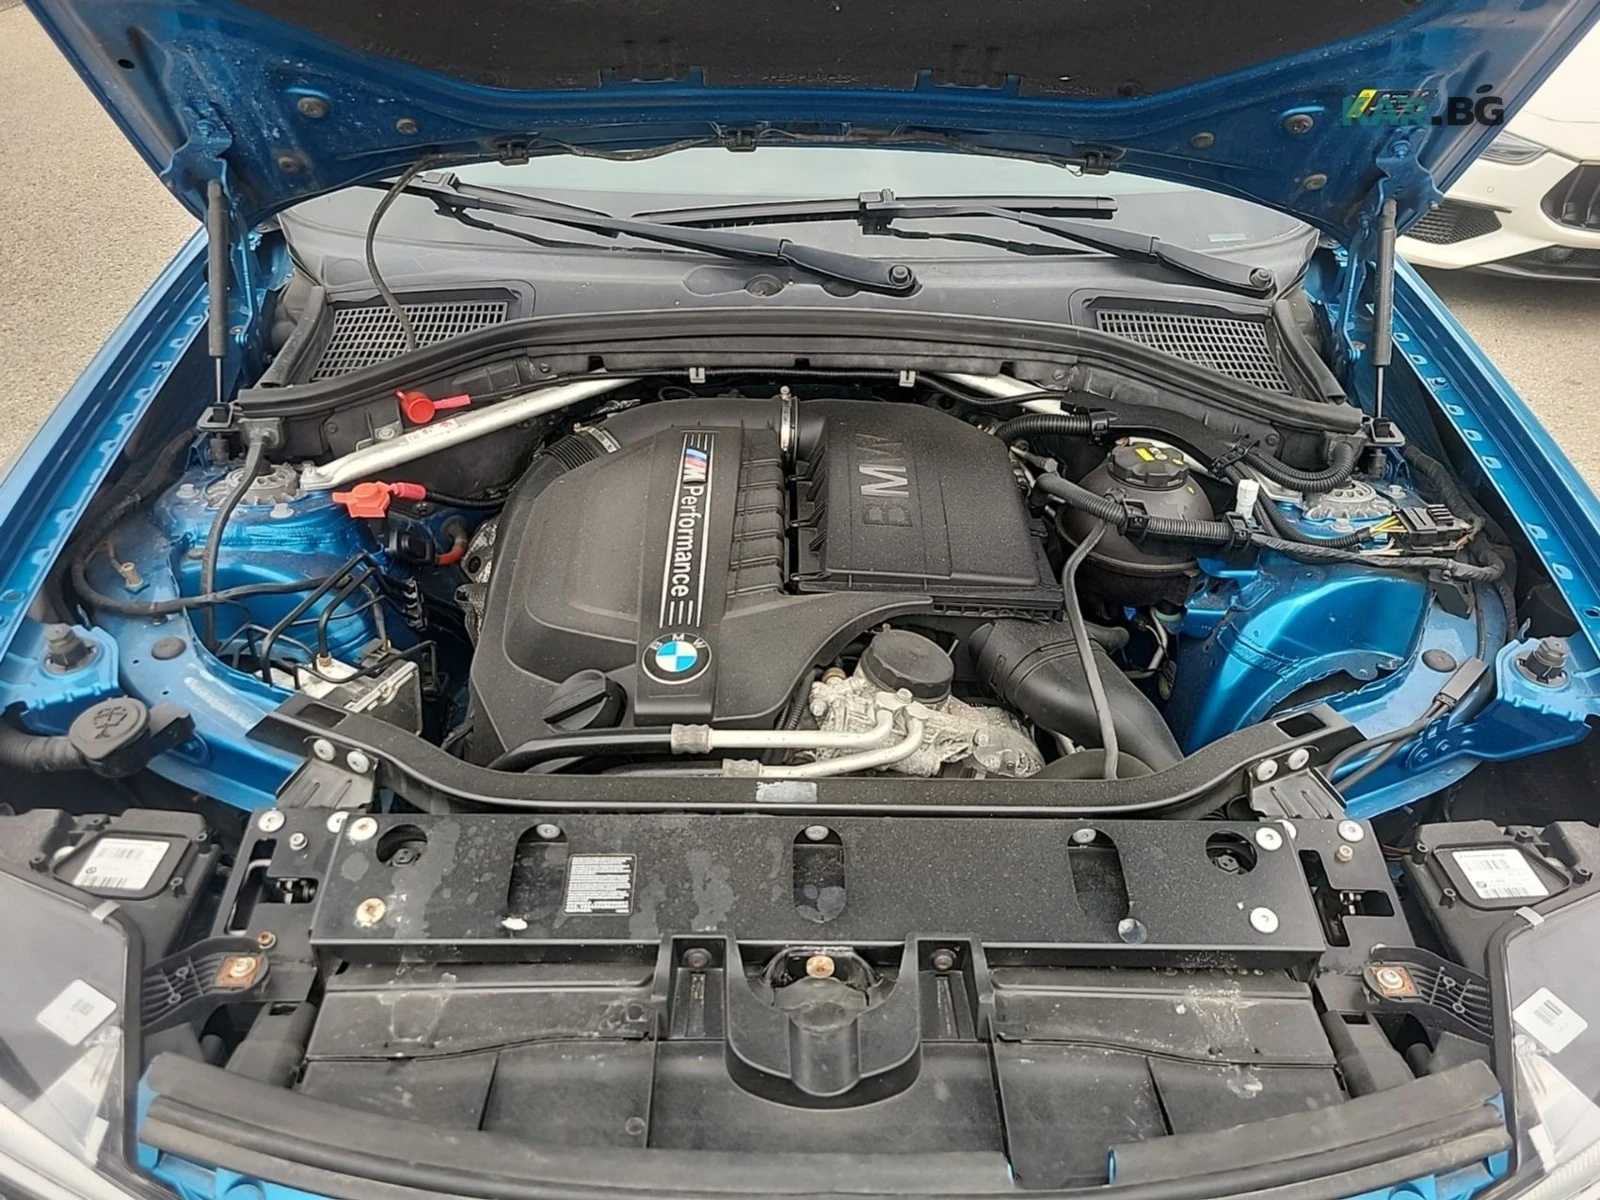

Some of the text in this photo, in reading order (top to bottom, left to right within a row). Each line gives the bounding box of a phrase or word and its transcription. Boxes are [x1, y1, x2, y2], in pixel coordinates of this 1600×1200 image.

[856, 433, 913, 528] BMW
[670, 486, 705, 598] Performance
[650, 633, 707, 651] BMW
